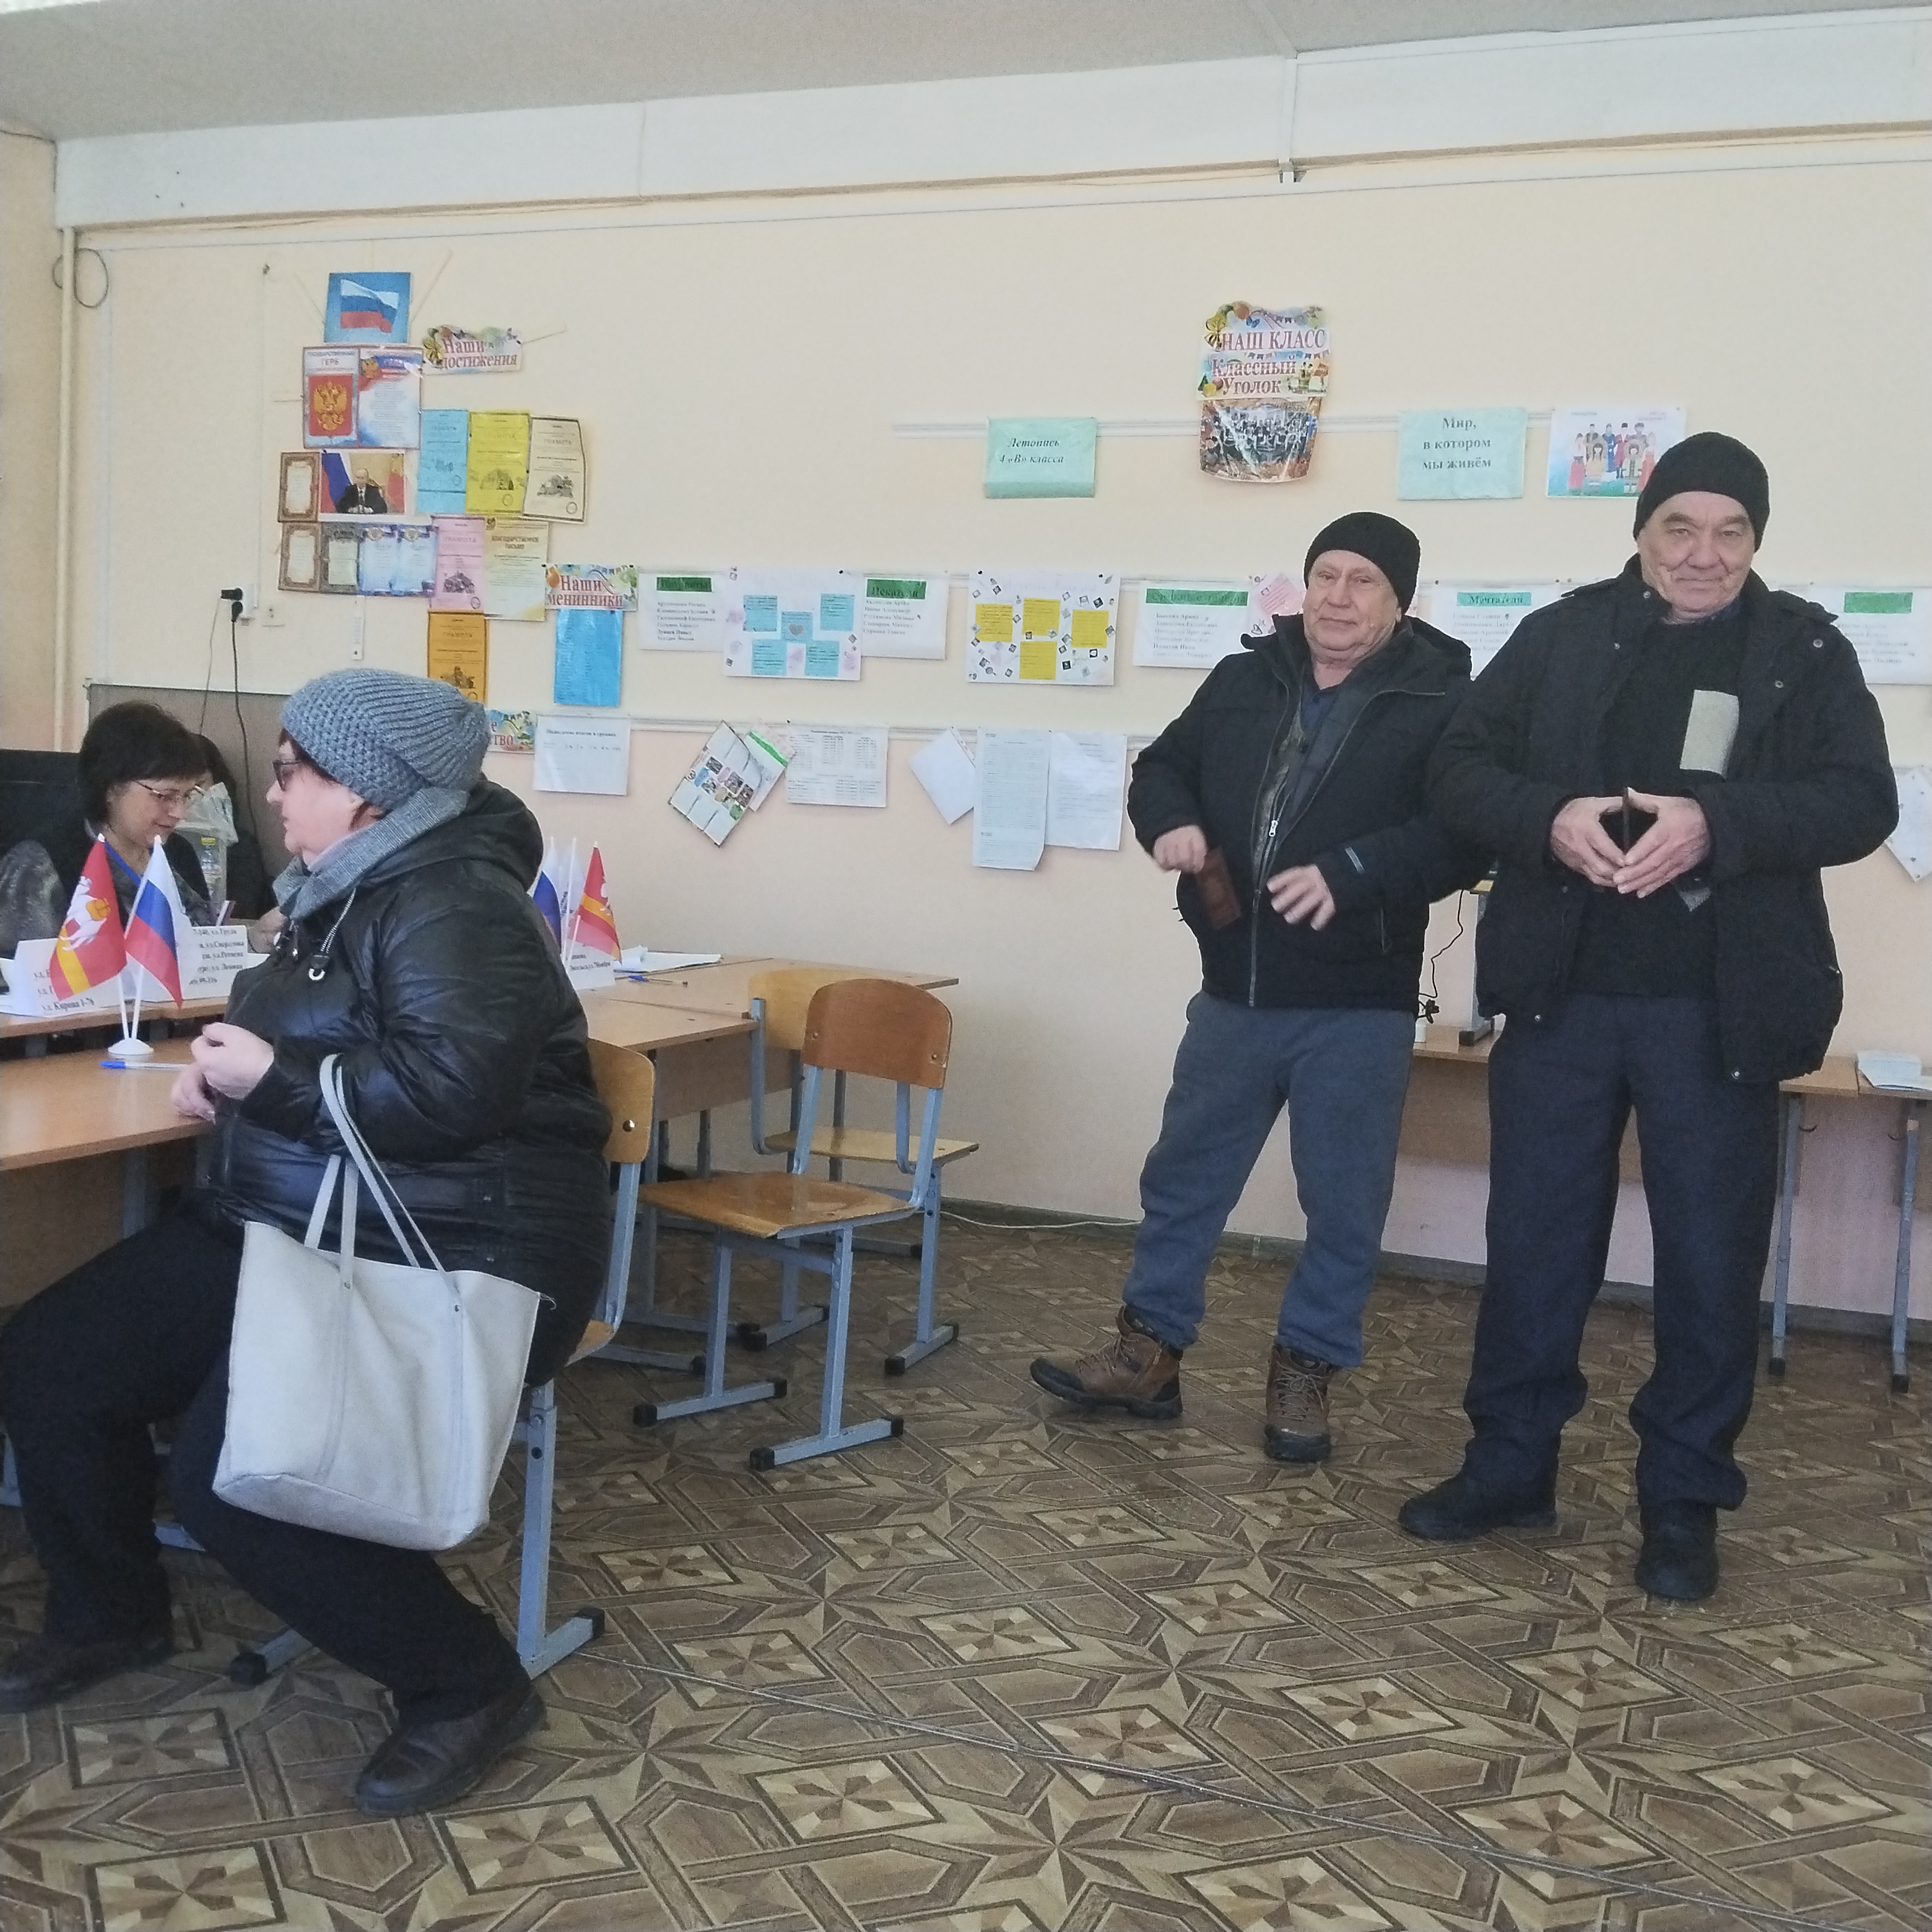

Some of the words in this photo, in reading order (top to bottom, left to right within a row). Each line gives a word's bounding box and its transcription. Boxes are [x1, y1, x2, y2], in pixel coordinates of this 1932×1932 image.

[442, 339, 484, 353] Наши
[1221, 332, 1263, 350] НАШ
[1269, 329, 1325, 350] КЛАСС
[1212, 355, 1297, 376] Классный
[1223, 378, 1281, 395] Уголок
[1443, 417, 1476, 430] Мир,
[1007, 438, 1060, 447] Летопись
[1424, 441, 1430, 450] в
[1435, 439, 1491, 451] котором
[999, 455, 1006, 463] 4
[1423, 461, 1443, 469] мы
[1447, 458, 1491, 469] живём
[560, 575, 601, 591] Наши
[546, 594, 623, 607] менинники
